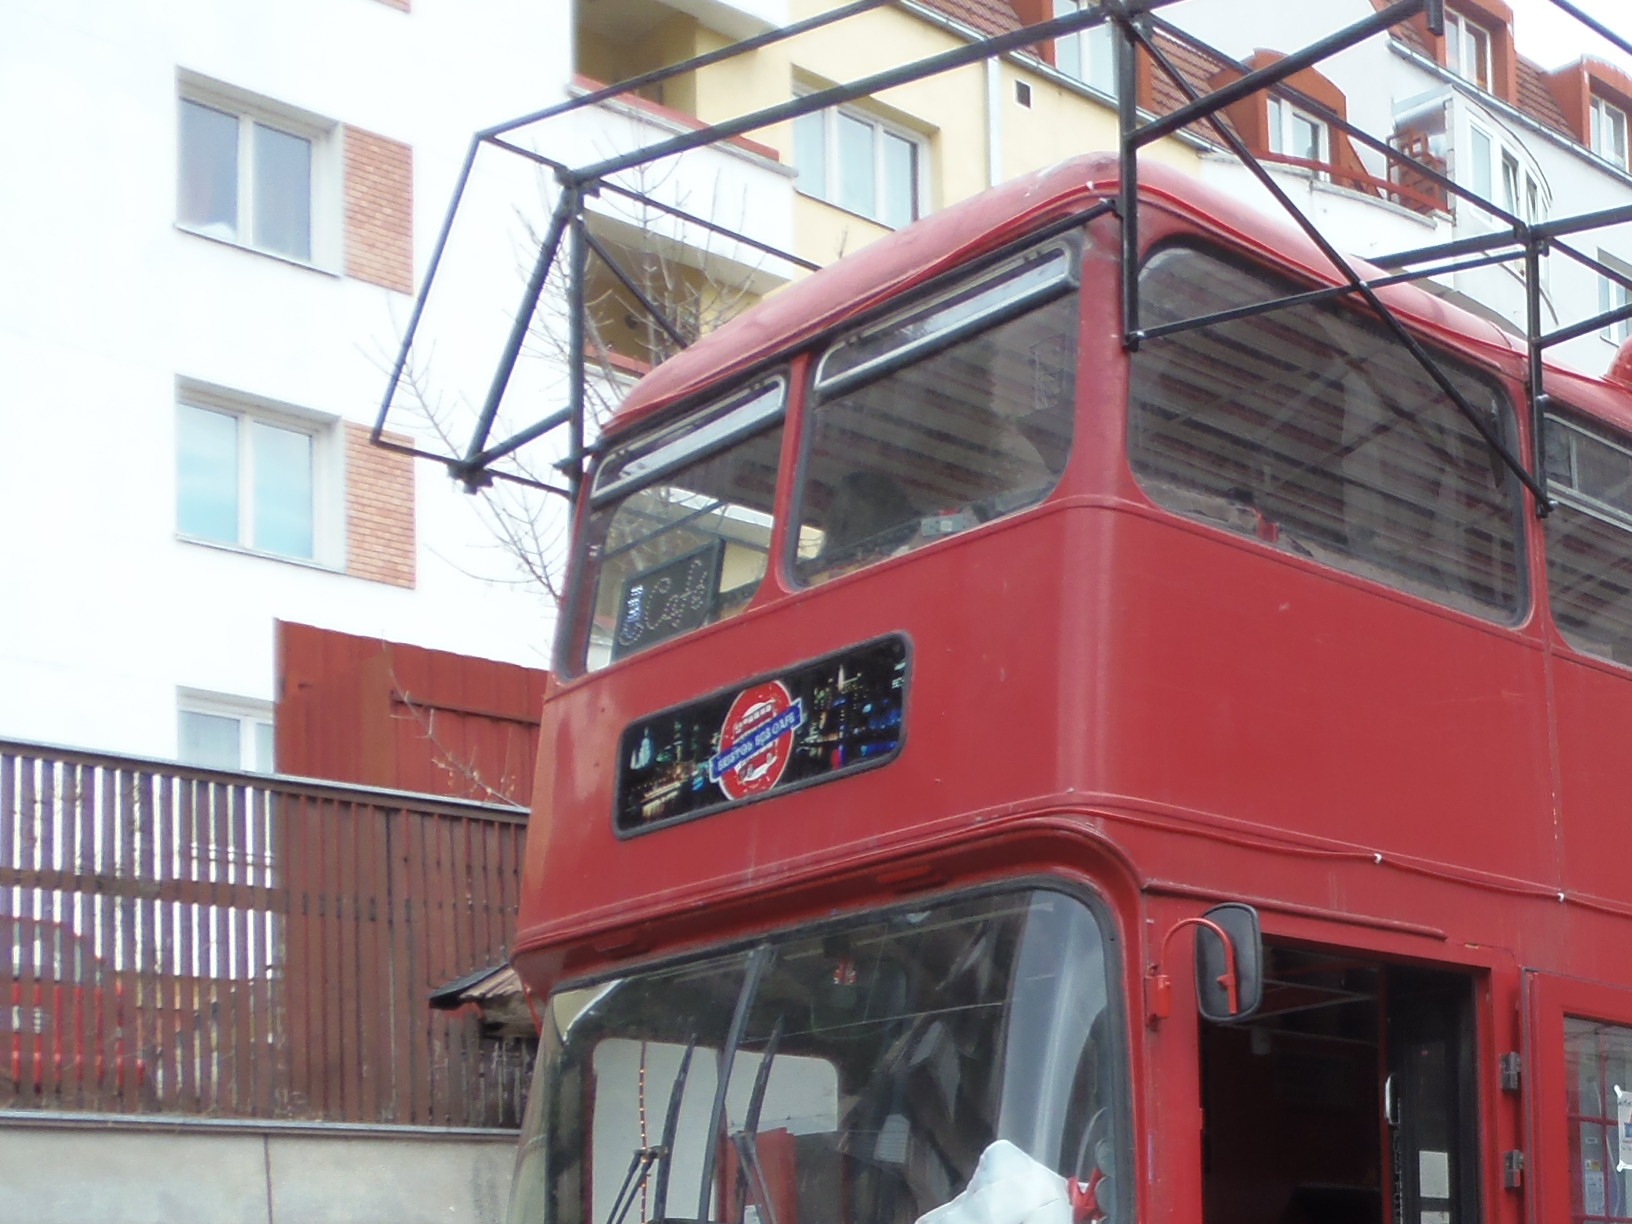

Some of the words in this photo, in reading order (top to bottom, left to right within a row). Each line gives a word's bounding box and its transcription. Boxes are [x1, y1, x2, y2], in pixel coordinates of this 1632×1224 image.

[717, 742, 753, 771] BRISTOL
[755, 728, 772, 746] BUS
[772, 712, 795, 735] CAFE
